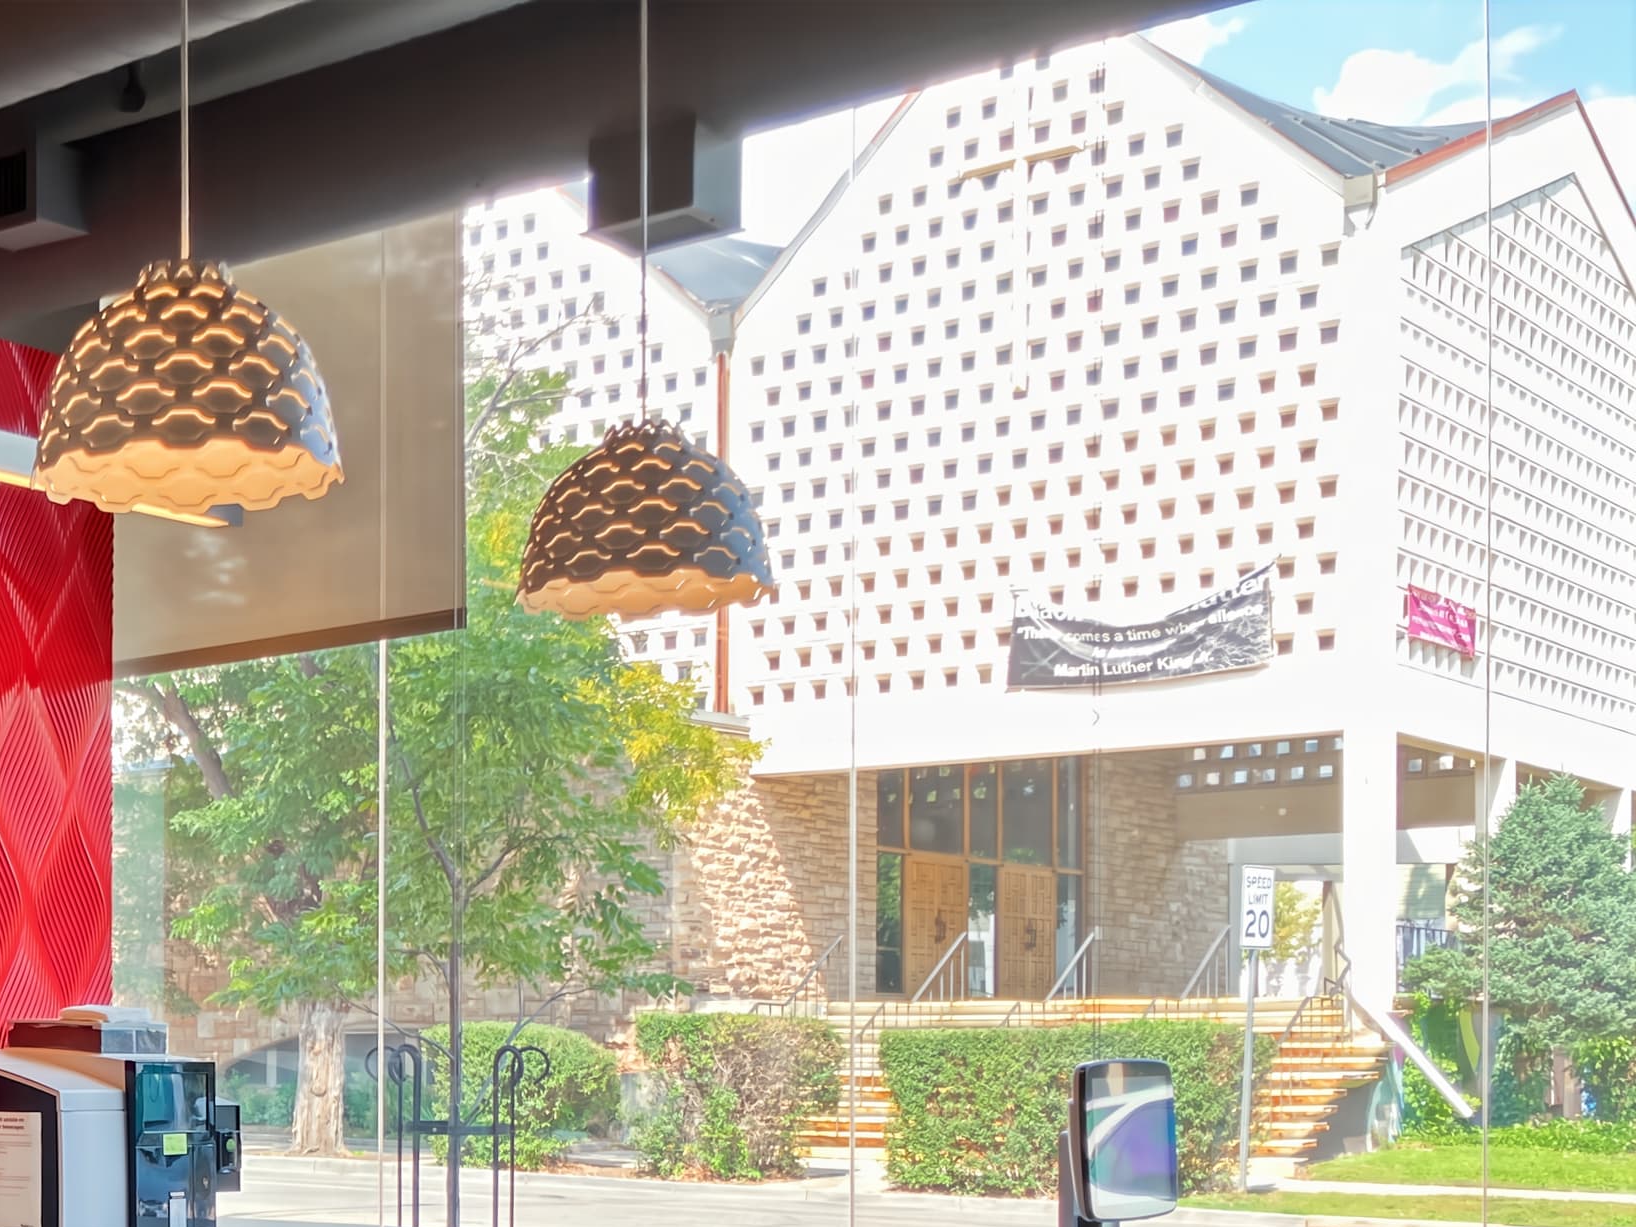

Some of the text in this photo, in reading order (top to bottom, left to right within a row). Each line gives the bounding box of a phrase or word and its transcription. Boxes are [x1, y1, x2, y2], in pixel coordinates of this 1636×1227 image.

[1126, 628, 1161, 641] time
[1053, 661, 1100, 677] Martin
[1103, 660, 1153, 676] Luther
[1246, 876, 1272, 889] SPEED
[1248, 893, 1268, 905] LIMIT
[1245, 909, 1270, 938] 20
